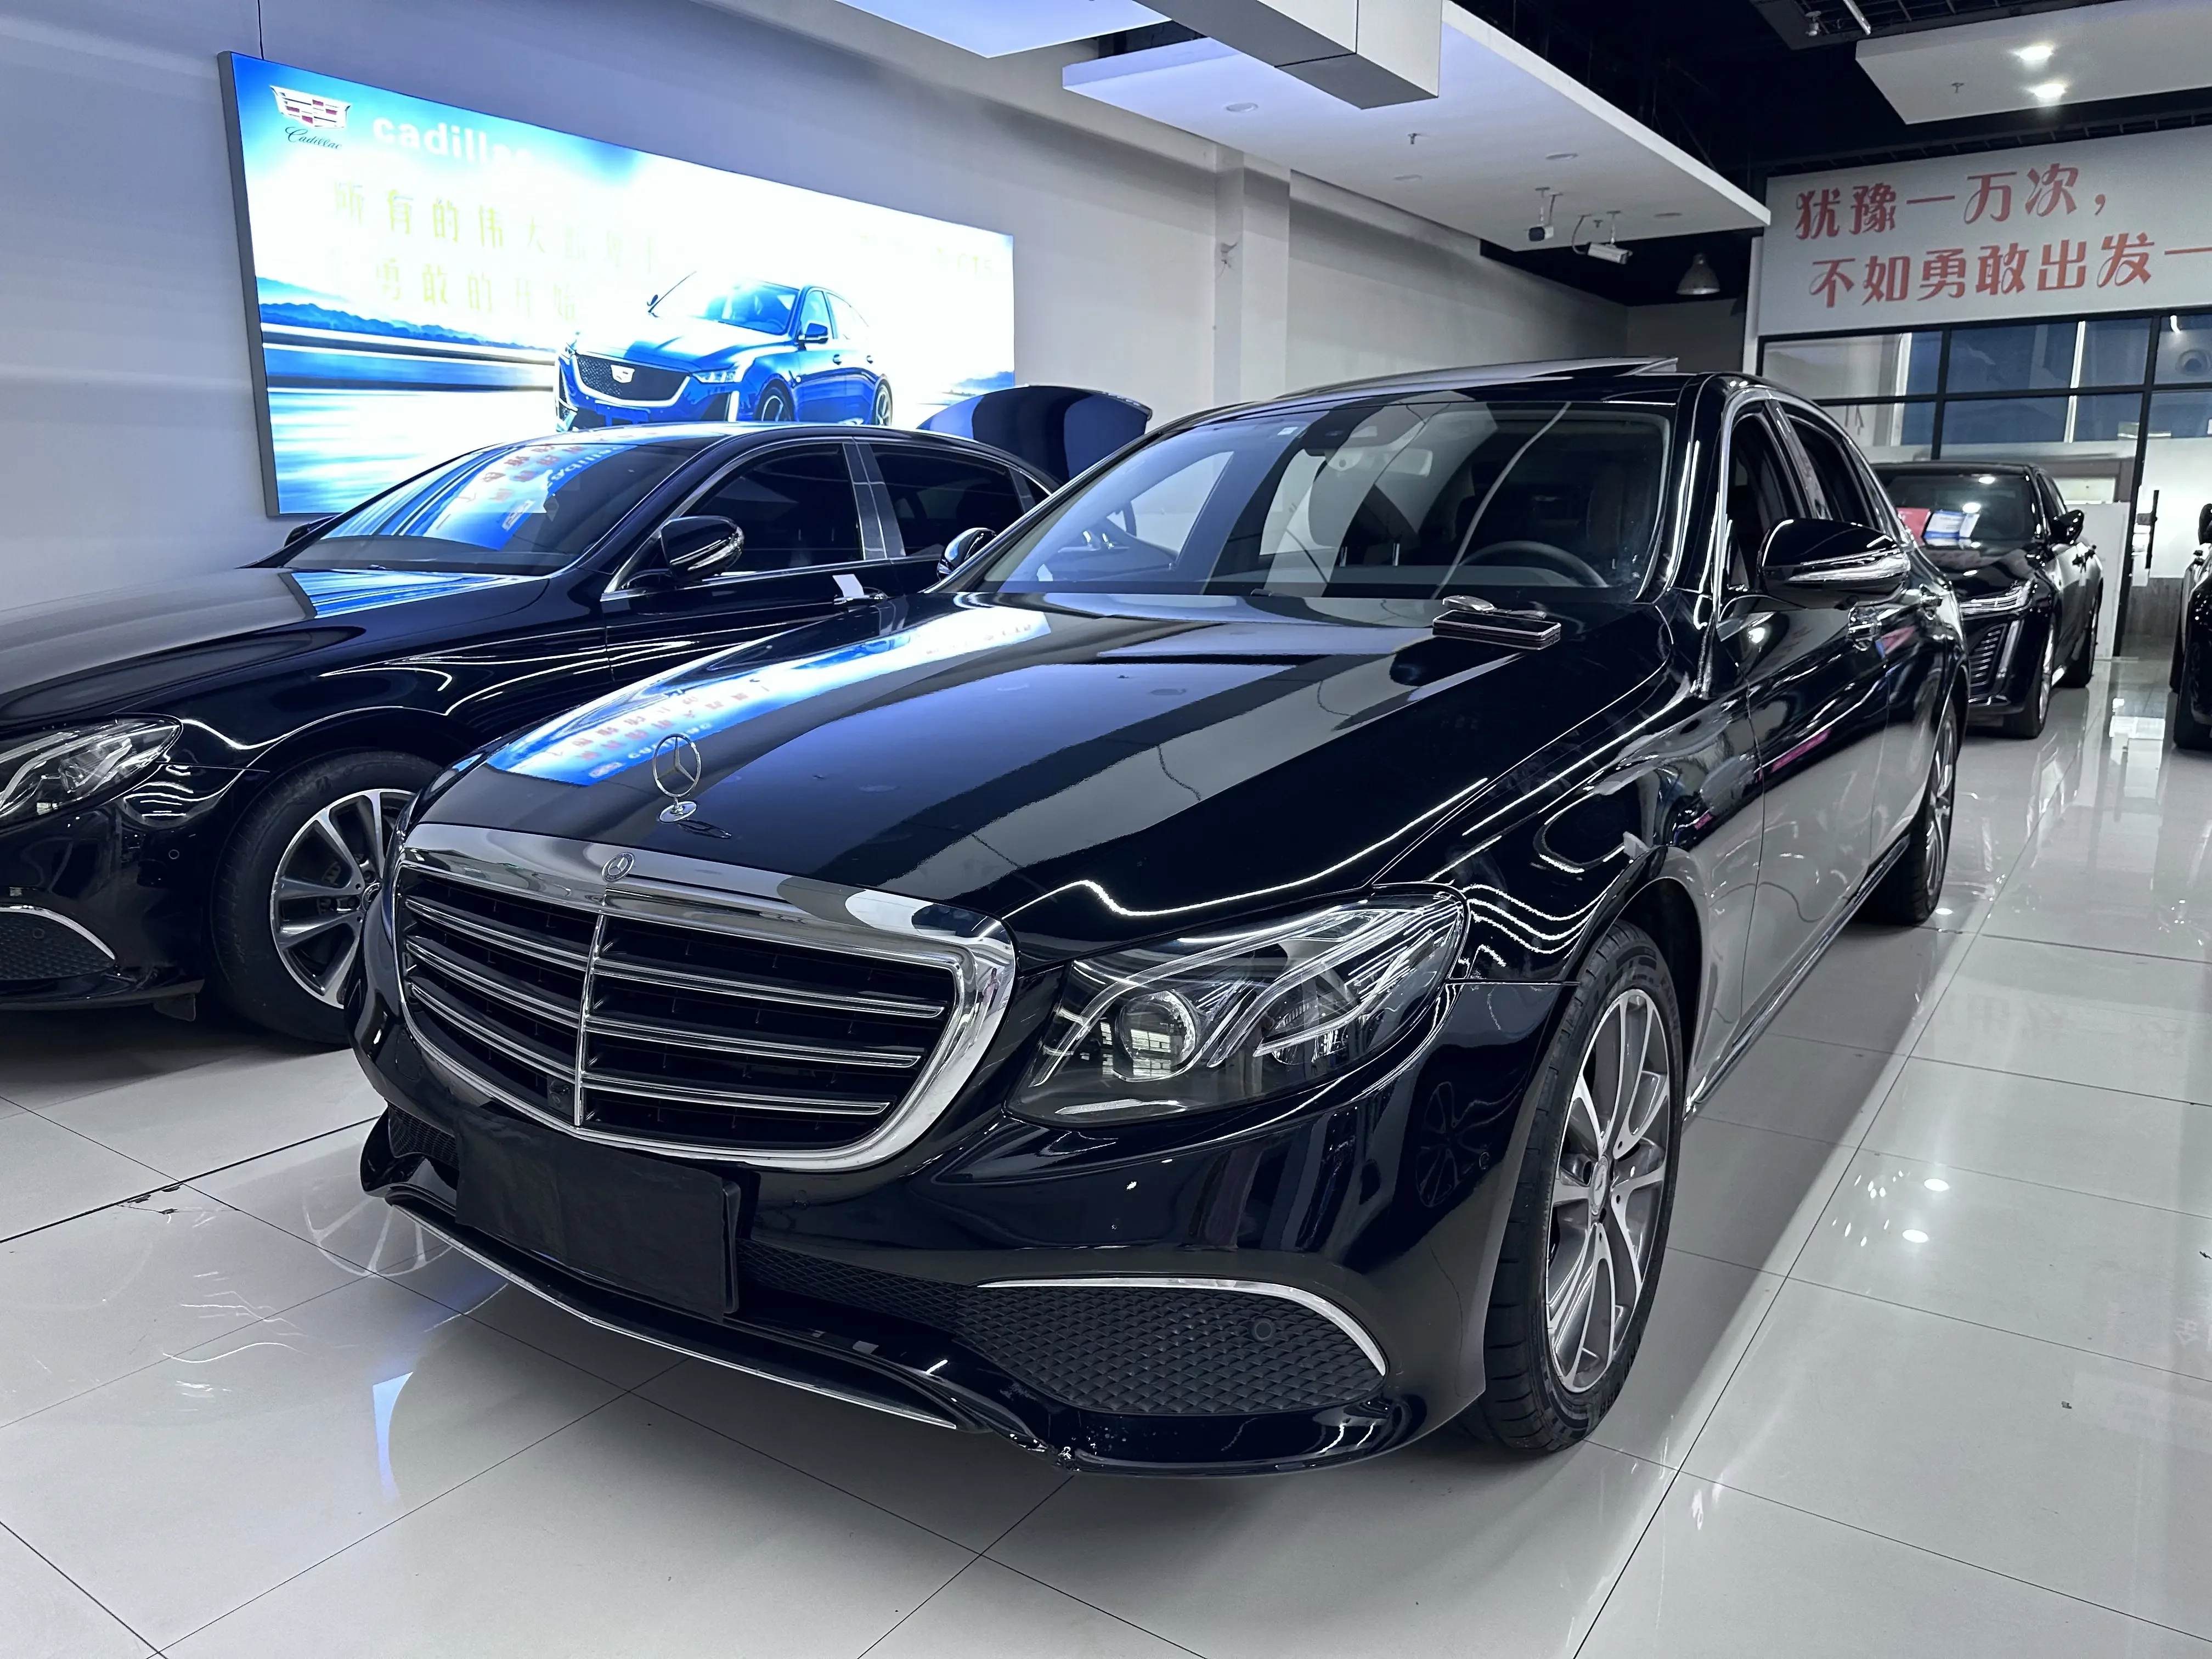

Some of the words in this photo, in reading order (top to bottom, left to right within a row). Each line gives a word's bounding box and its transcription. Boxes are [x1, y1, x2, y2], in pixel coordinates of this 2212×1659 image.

[285, 126, 342, 150] Cadillac
[1809, 232, 2212, 308] 不如勇敢出发一
